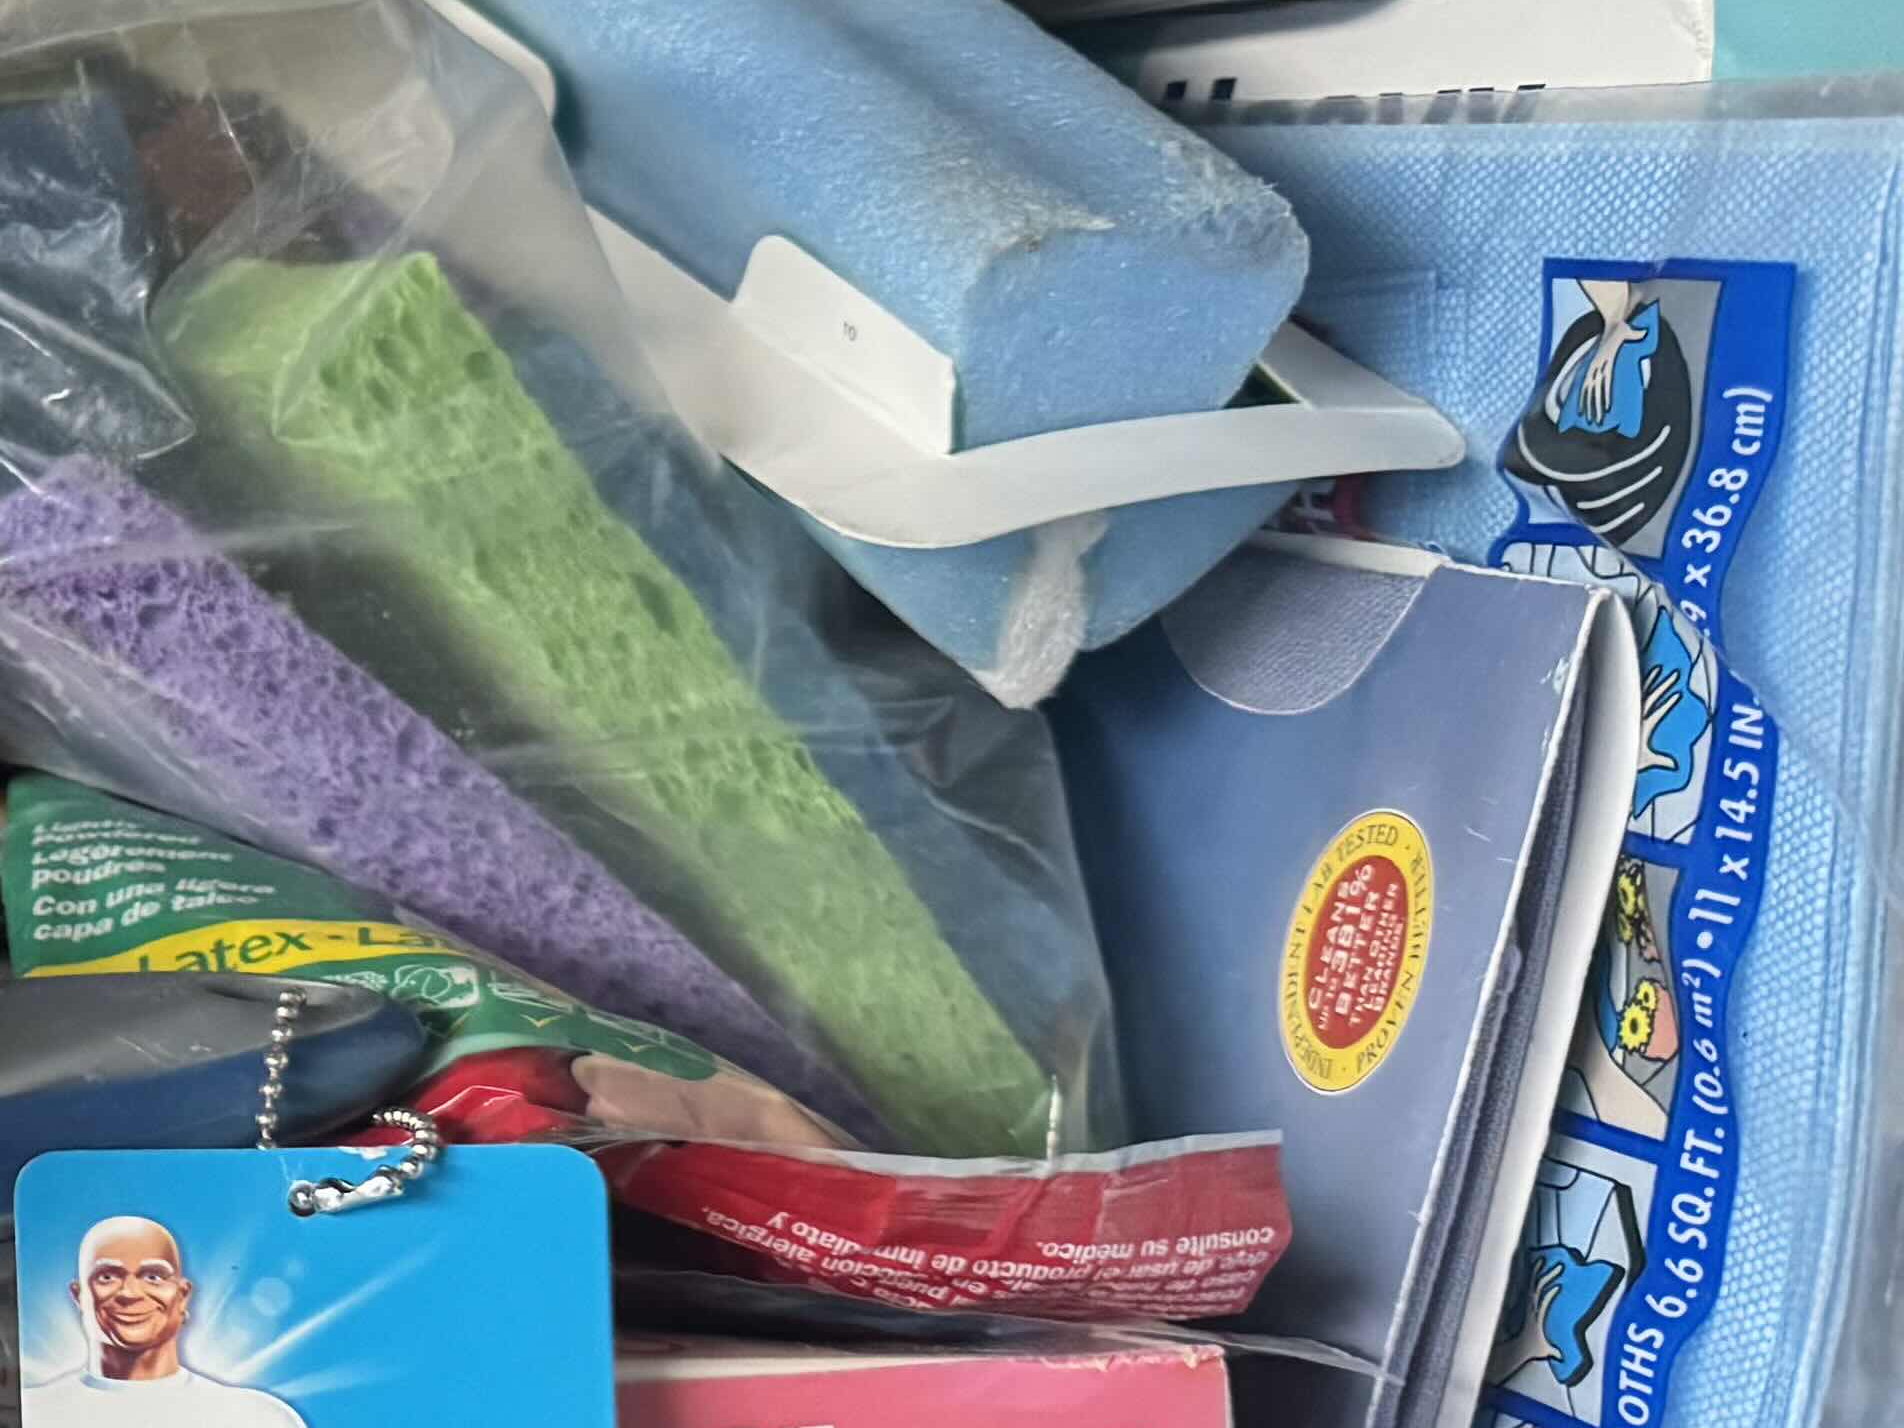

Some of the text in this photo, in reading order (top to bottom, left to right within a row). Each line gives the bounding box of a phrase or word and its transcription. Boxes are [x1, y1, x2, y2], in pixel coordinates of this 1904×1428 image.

[1722, 387, 1773, 455] cm)
[1681, 467, 1749, 553] 36.8
[1684, 564, 1712, 588] x
[1715, 758, 1759, 841] 14.5
[1719, 853, 1750, 881] x
[32, 894, 96, 916] Con
[106, 882, 165, 908] una
[33, 891, 259, 942] capa de talco
[1688, 888, 1741, 925] 11
[139, 929, 313, 973] Latex
[1691, 1039, 1728, 1115] (0.6
[767, 1211, 790, 1230] y
[792, 1222, 925, 1269] inmdiato
[1141, 1239, 1169, 1260] su
[1176, 1226, 1275, 1257] consulte
[932, 1254, 967, 1274] de
[972, 1260, 1092, 1281] producto
[1183, 1259, 1212, 1275] de
[1645, 1257, 1705, 1319] 6.6
